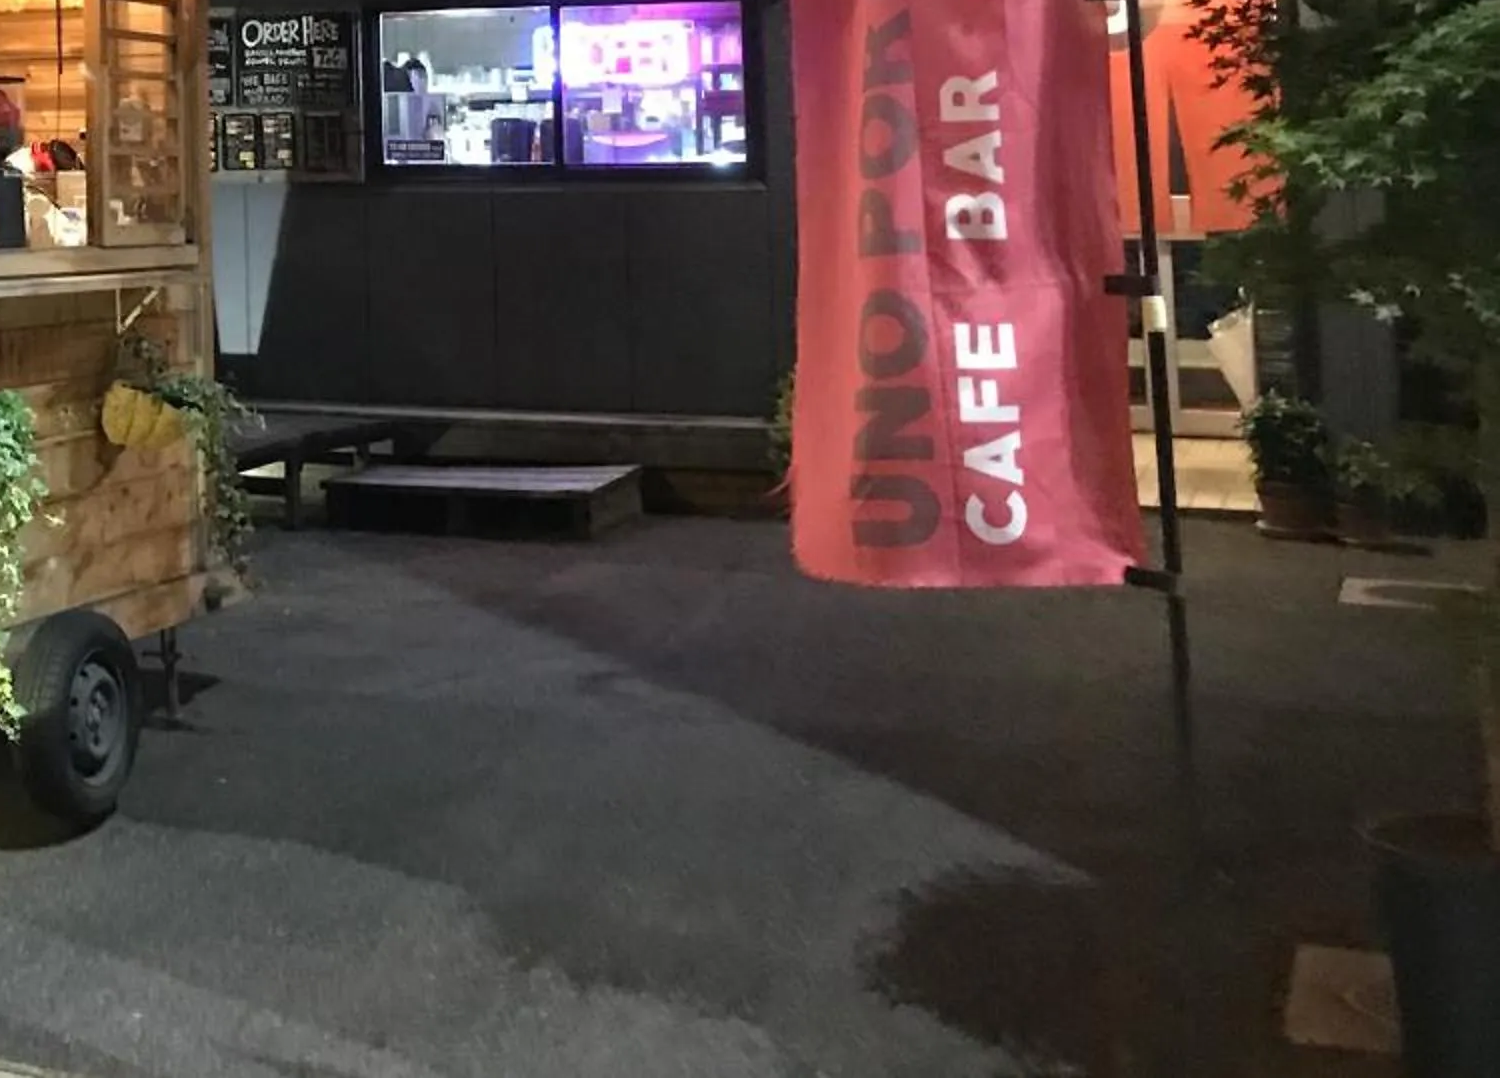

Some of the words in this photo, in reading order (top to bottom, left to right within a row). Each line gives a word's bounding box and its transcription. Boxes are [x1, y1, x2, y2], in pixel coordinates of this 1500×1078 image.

[940, 70, 1009, 241] BAR
[847, 286, 943, 551] UNO
[954, 322, 1029, 547] CAFE
